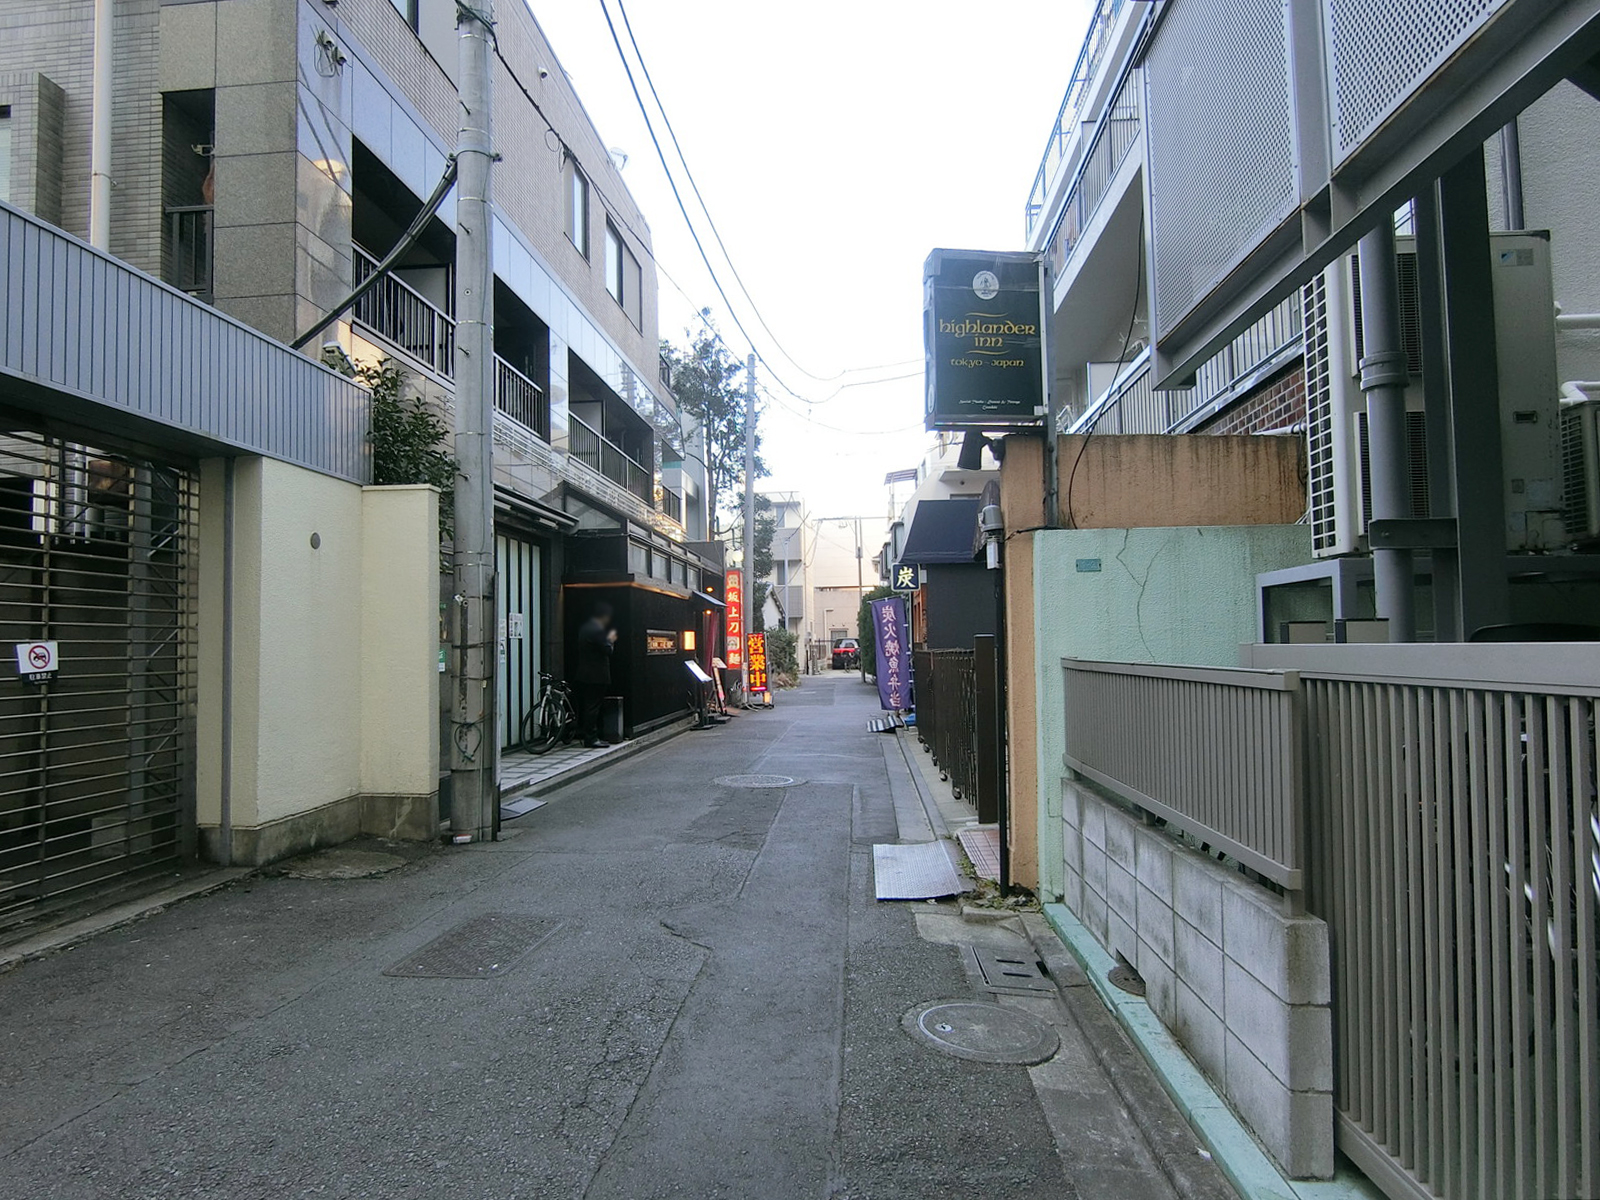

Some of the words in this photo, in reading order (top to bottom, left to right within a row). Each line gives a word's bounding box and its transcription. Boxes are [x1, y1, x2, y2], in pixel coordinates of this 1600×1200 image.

[939, 318, 1036, 338] highlander
[974, 333, 1003, 347] inn
[951, 358, 983, 369] tokyo
[896, 566, 916, 588] 炭
[748, 634, 768, 687] 営業中
